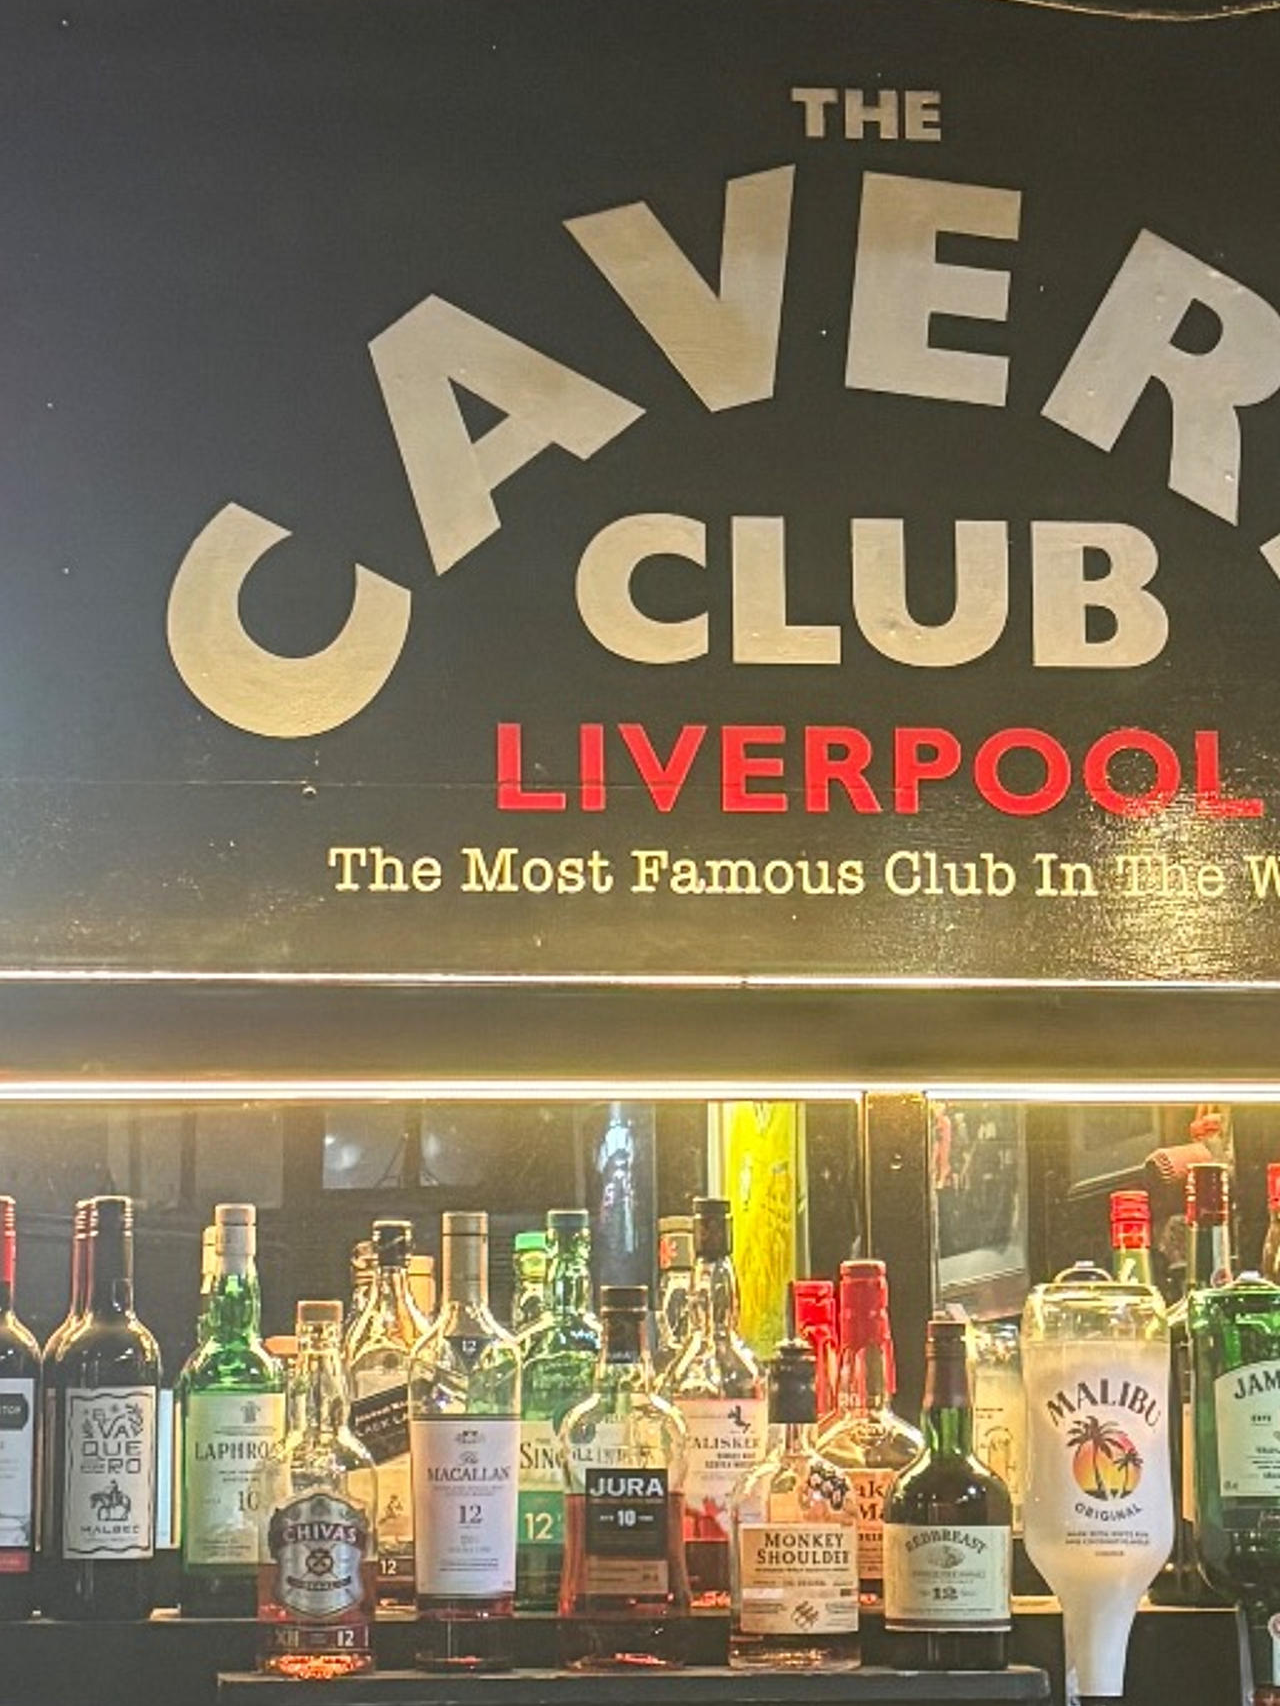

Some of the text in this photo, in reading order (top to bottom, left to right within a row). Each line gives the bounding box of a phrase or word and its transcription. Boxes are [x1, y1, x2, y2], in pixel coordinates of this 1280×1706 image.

[791, 87, 942, 140] THE
[575, 513, 1170, 668] CLUB
[495, 724, 1264, 819] LIVERPOOL
[327, 847, 442, 895] The
[459, 849, 613, 896] Most
[630, 849, 867, 899] Famous
[883, 851, 1014, 900] Club
[1032, 853, 1097, 900] In
[1116, 853, 1227, 901] The
[1047, 1378, 1162, 1428] MALIBU
[426, 1465, 510, 1483] MACALLAN
[589, 1477, 665, 1498] JURA
[457, 1504, 483, 1525] 12
[616, 1509, 637, 1527] 10
[1074, 1501, 1143, 1523] ORIGINAL
[282, 1523, 357, 1543] CHIVAS
[524, 1512, 553, 1540] 12
[764, 1532, 845, 1549] MONKEY
[905, 1528, 987, 1554] REDBREAST
[336, 1629, 355, 1648] 12
